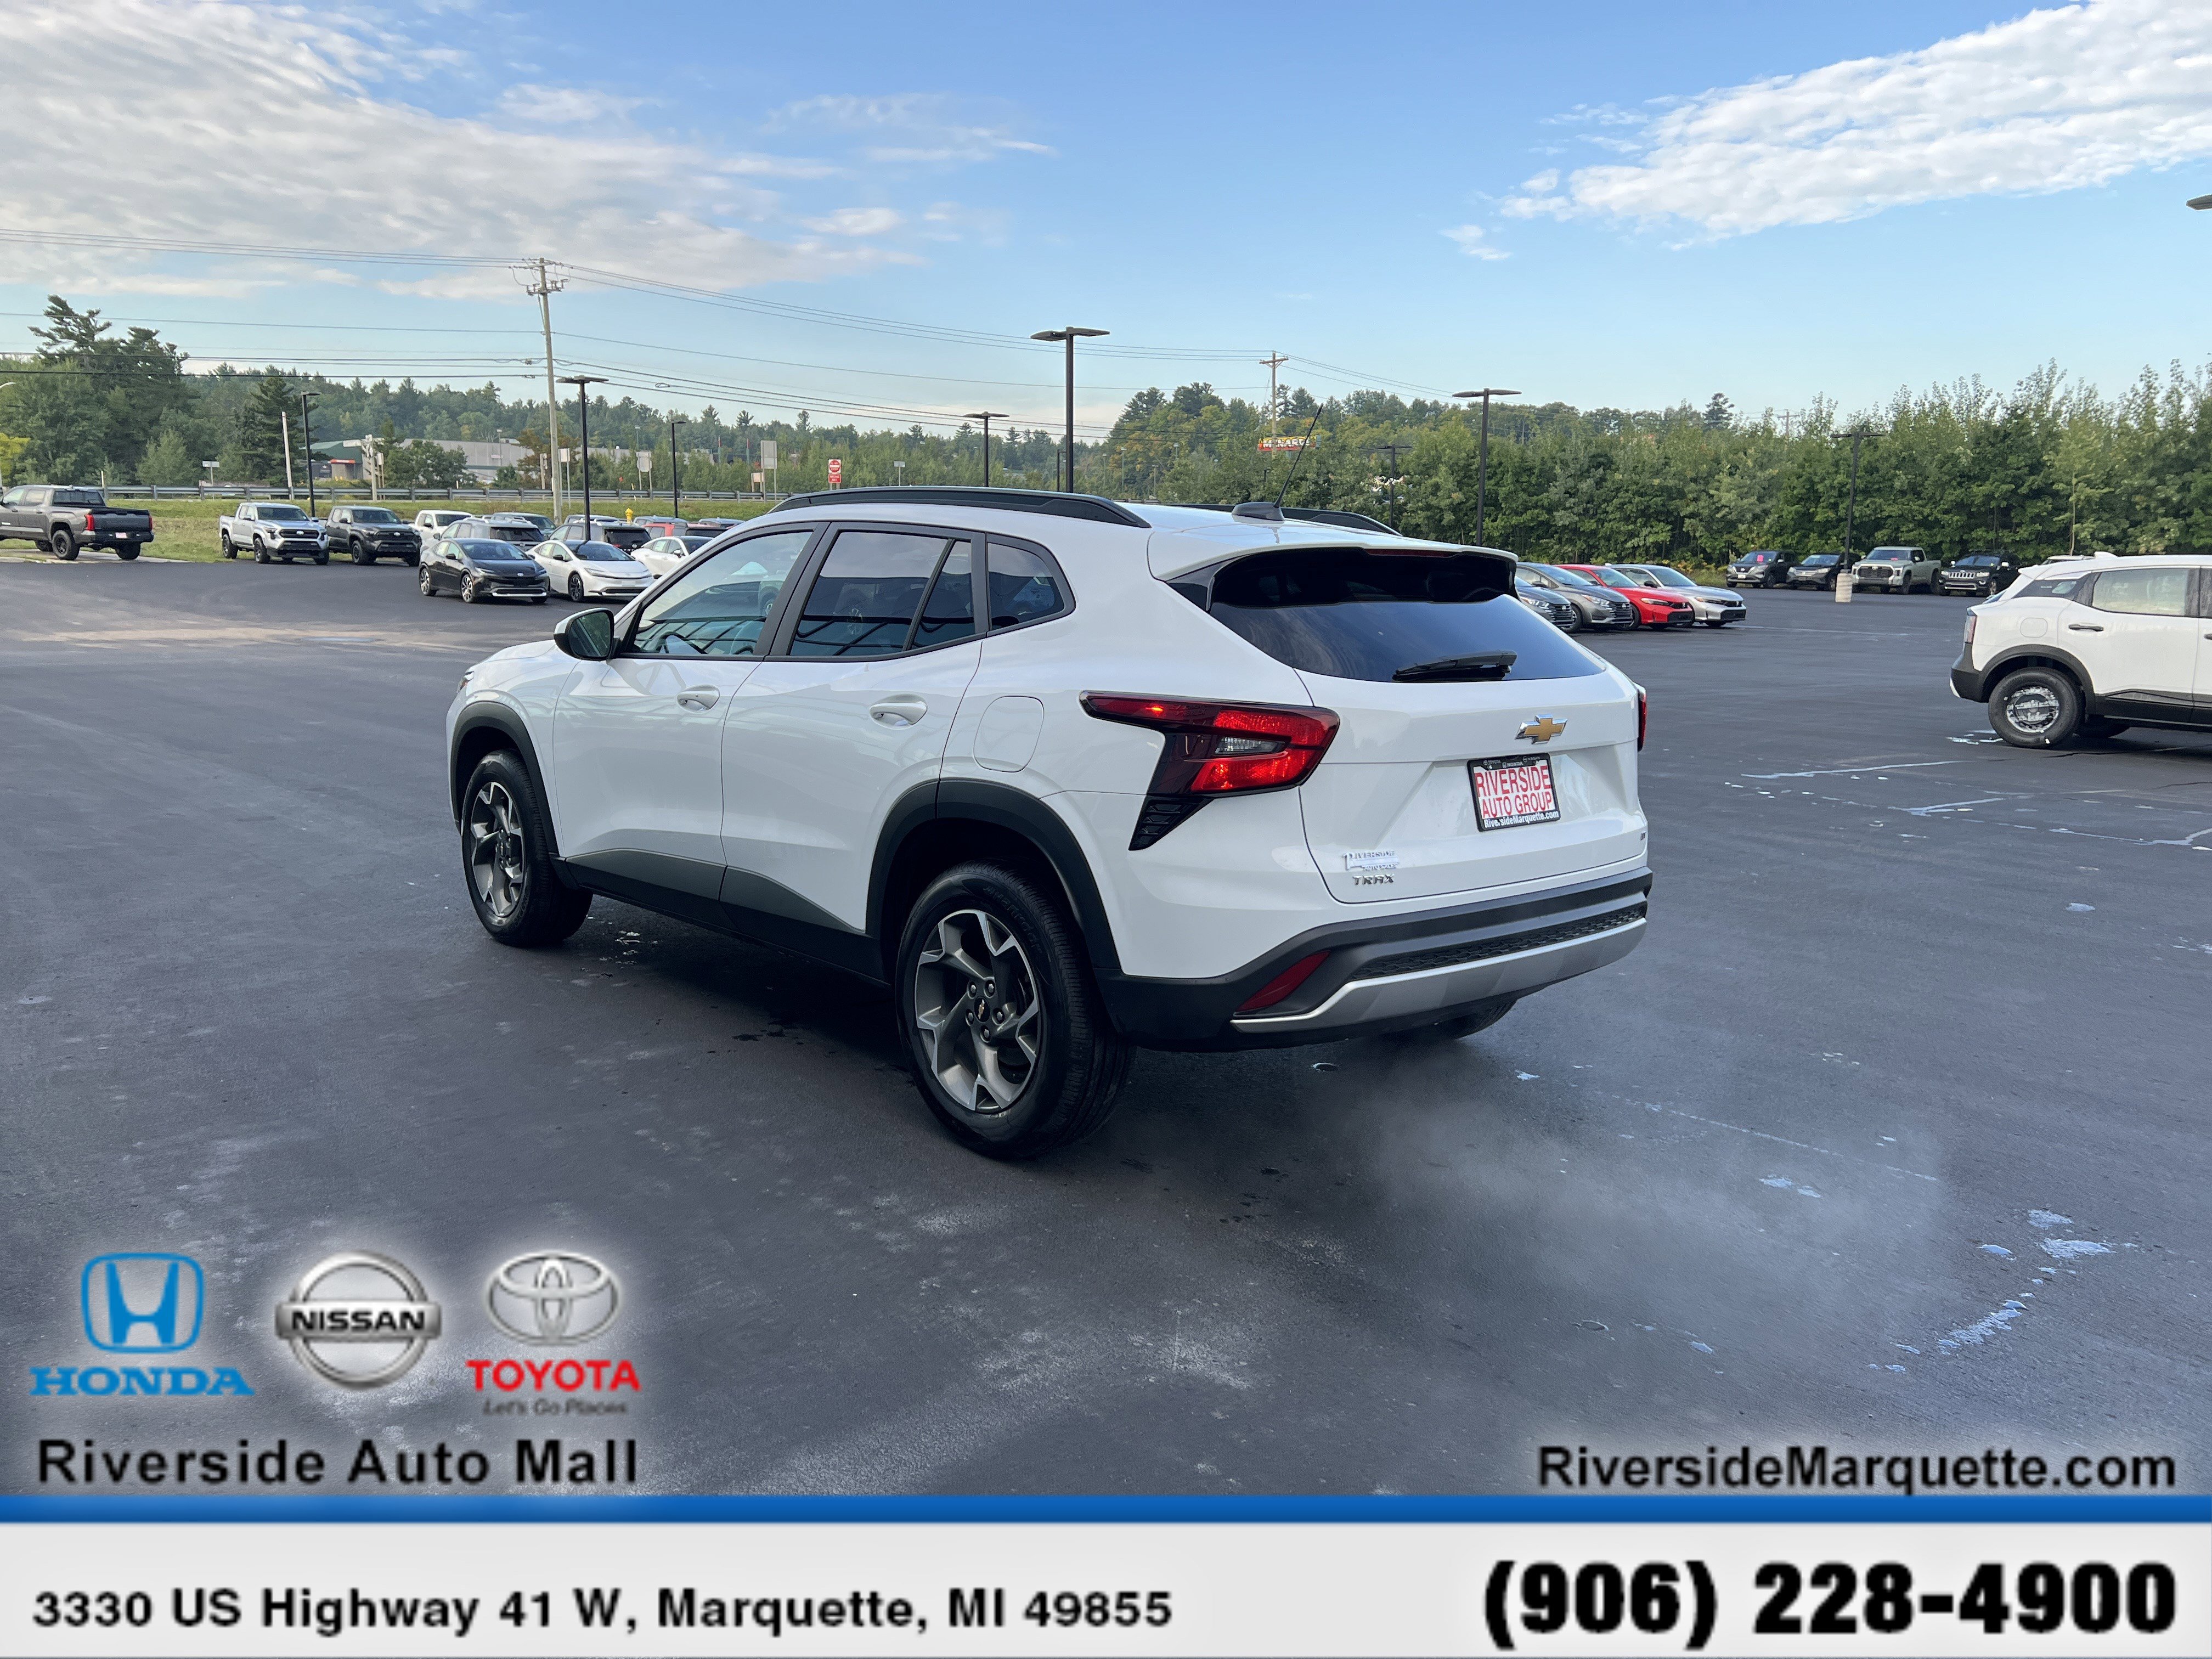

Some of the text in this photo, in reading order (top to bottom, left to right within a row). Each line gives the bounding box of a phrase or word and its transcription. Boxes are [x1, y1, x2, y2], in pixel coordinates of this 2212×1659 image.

[1263, 439, 1310, 448] MNARDS
[1475, 765, 1552, 797] RIVERSIDE
[1482, 791, 1552, 818] AUTO GROUP
[1352, 873, 1395, 885] TRAX
